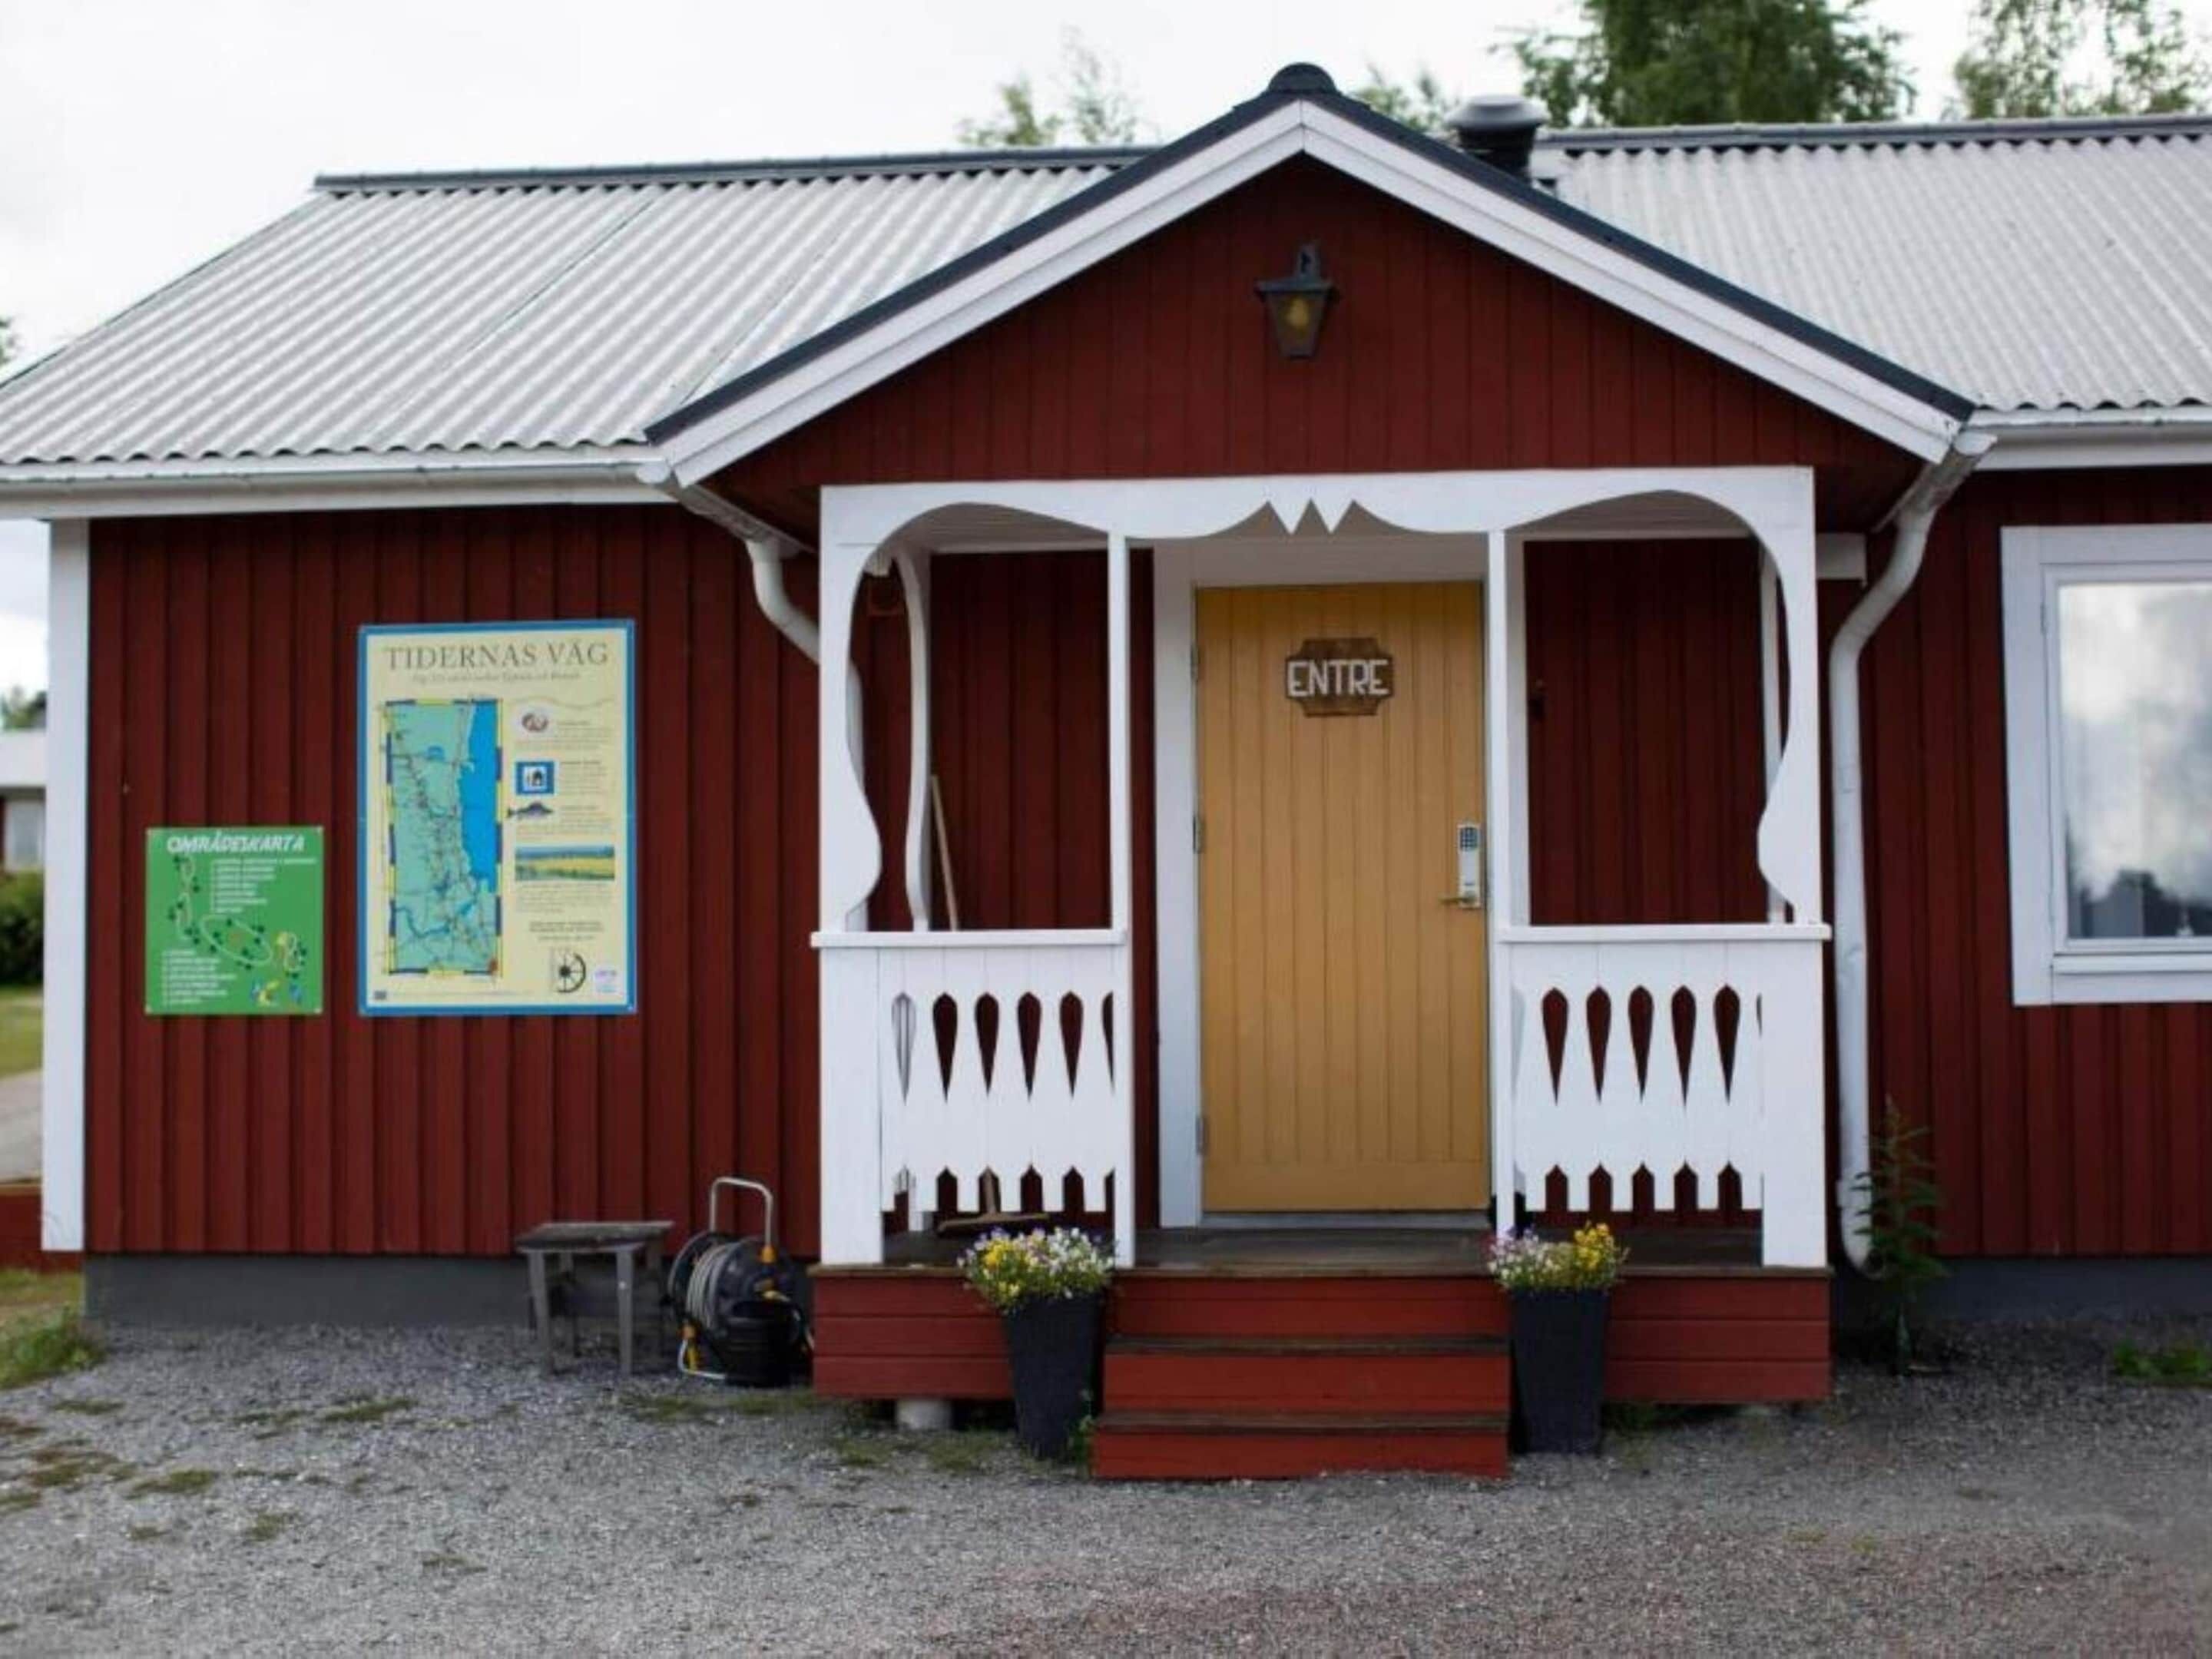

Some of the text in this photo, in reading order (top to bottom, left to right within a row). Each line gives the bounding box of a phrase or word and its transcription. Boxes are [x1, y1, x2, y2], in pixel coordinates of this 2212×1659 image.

[386, 642, 537, 670] TIDERNAS
[1287, 658, 1389, 697] ENTRE
[167, 830, 305, 853] OMRÅDESKARTA
